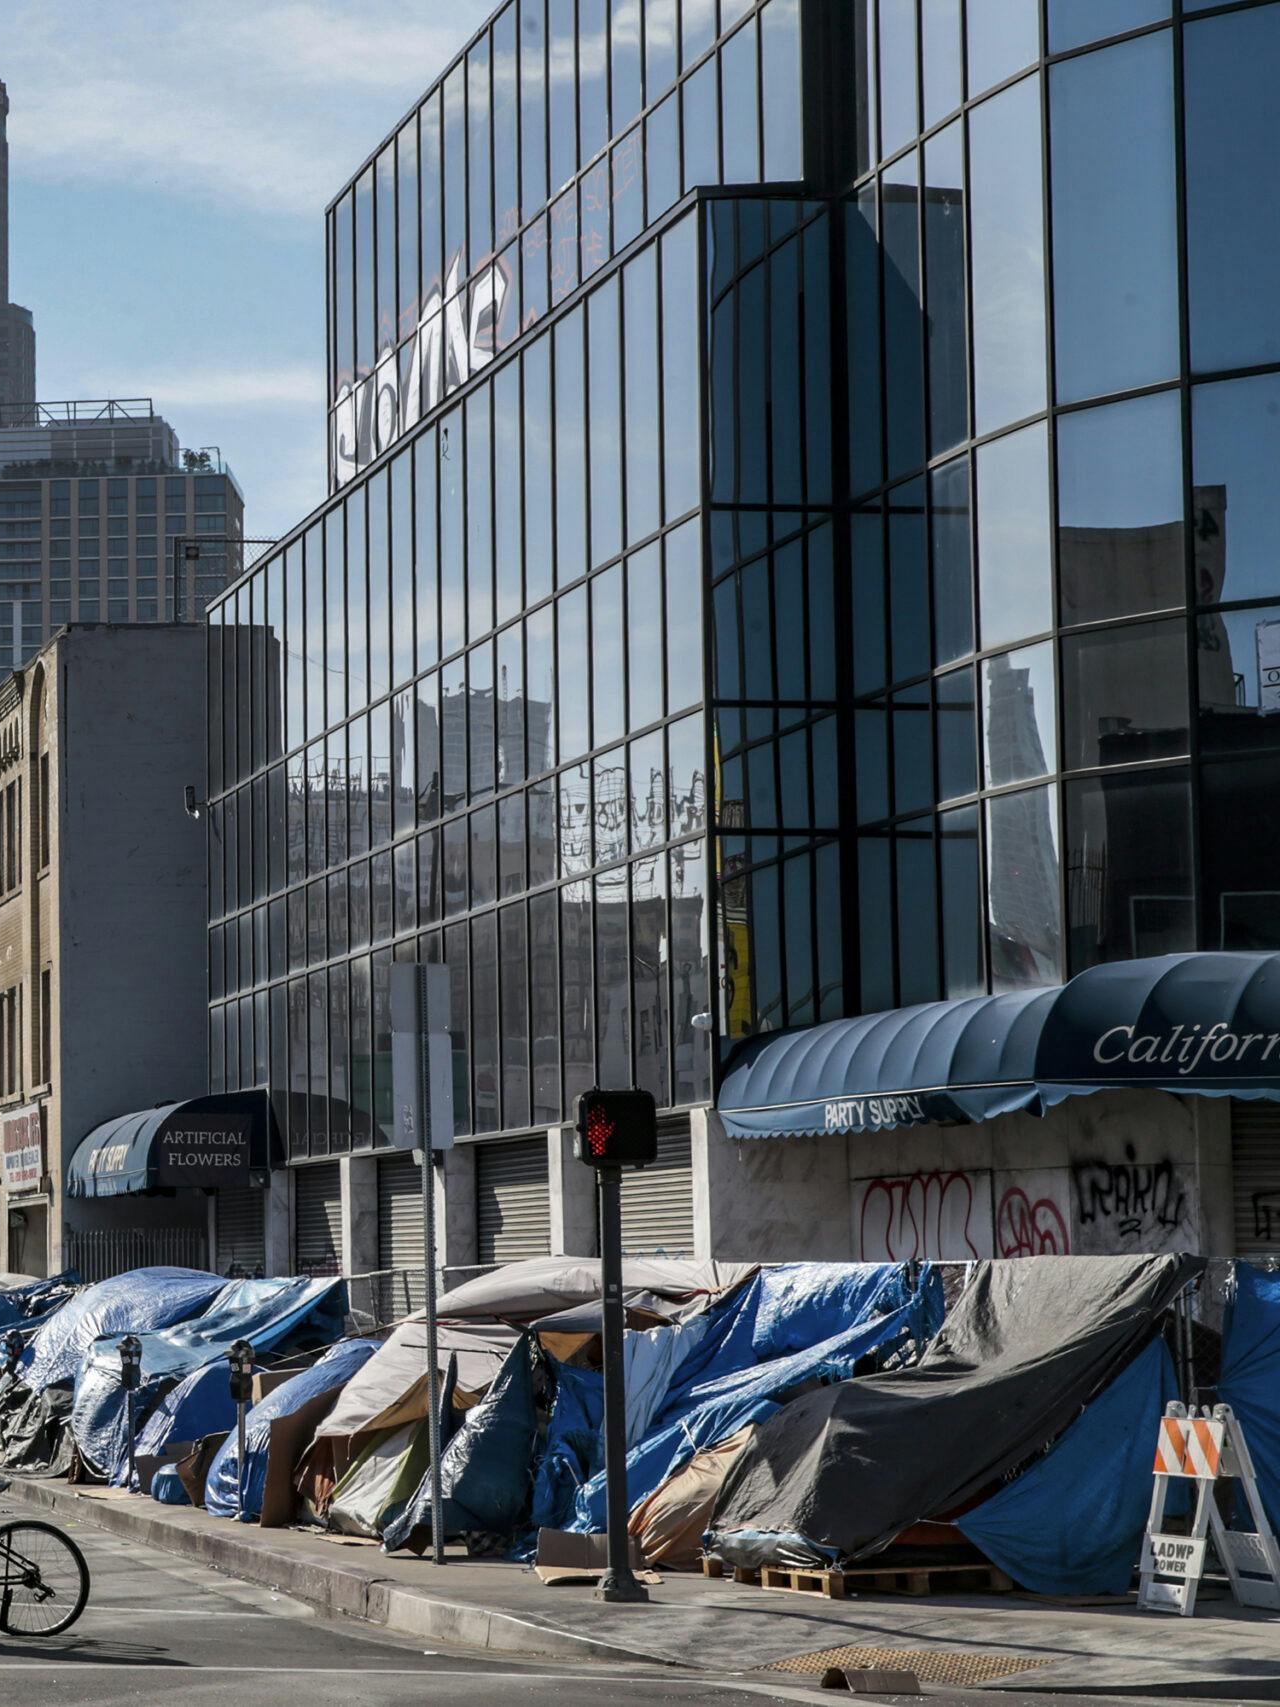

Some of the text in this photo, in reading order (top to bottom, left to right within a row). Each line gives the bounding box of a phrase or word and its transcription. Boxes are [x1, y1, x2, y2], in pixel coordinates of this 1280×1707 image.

[825, 1096, 925, 1128] PARTY SUPPLY
[163, 1131, 246, 1145] ARTIFICIAL
[168, 1153, 242, 1167] FLOWERS
[1150, 1541, 1194, 1559] LADWP
[1153, 1560, 1186, 1573] POWER
